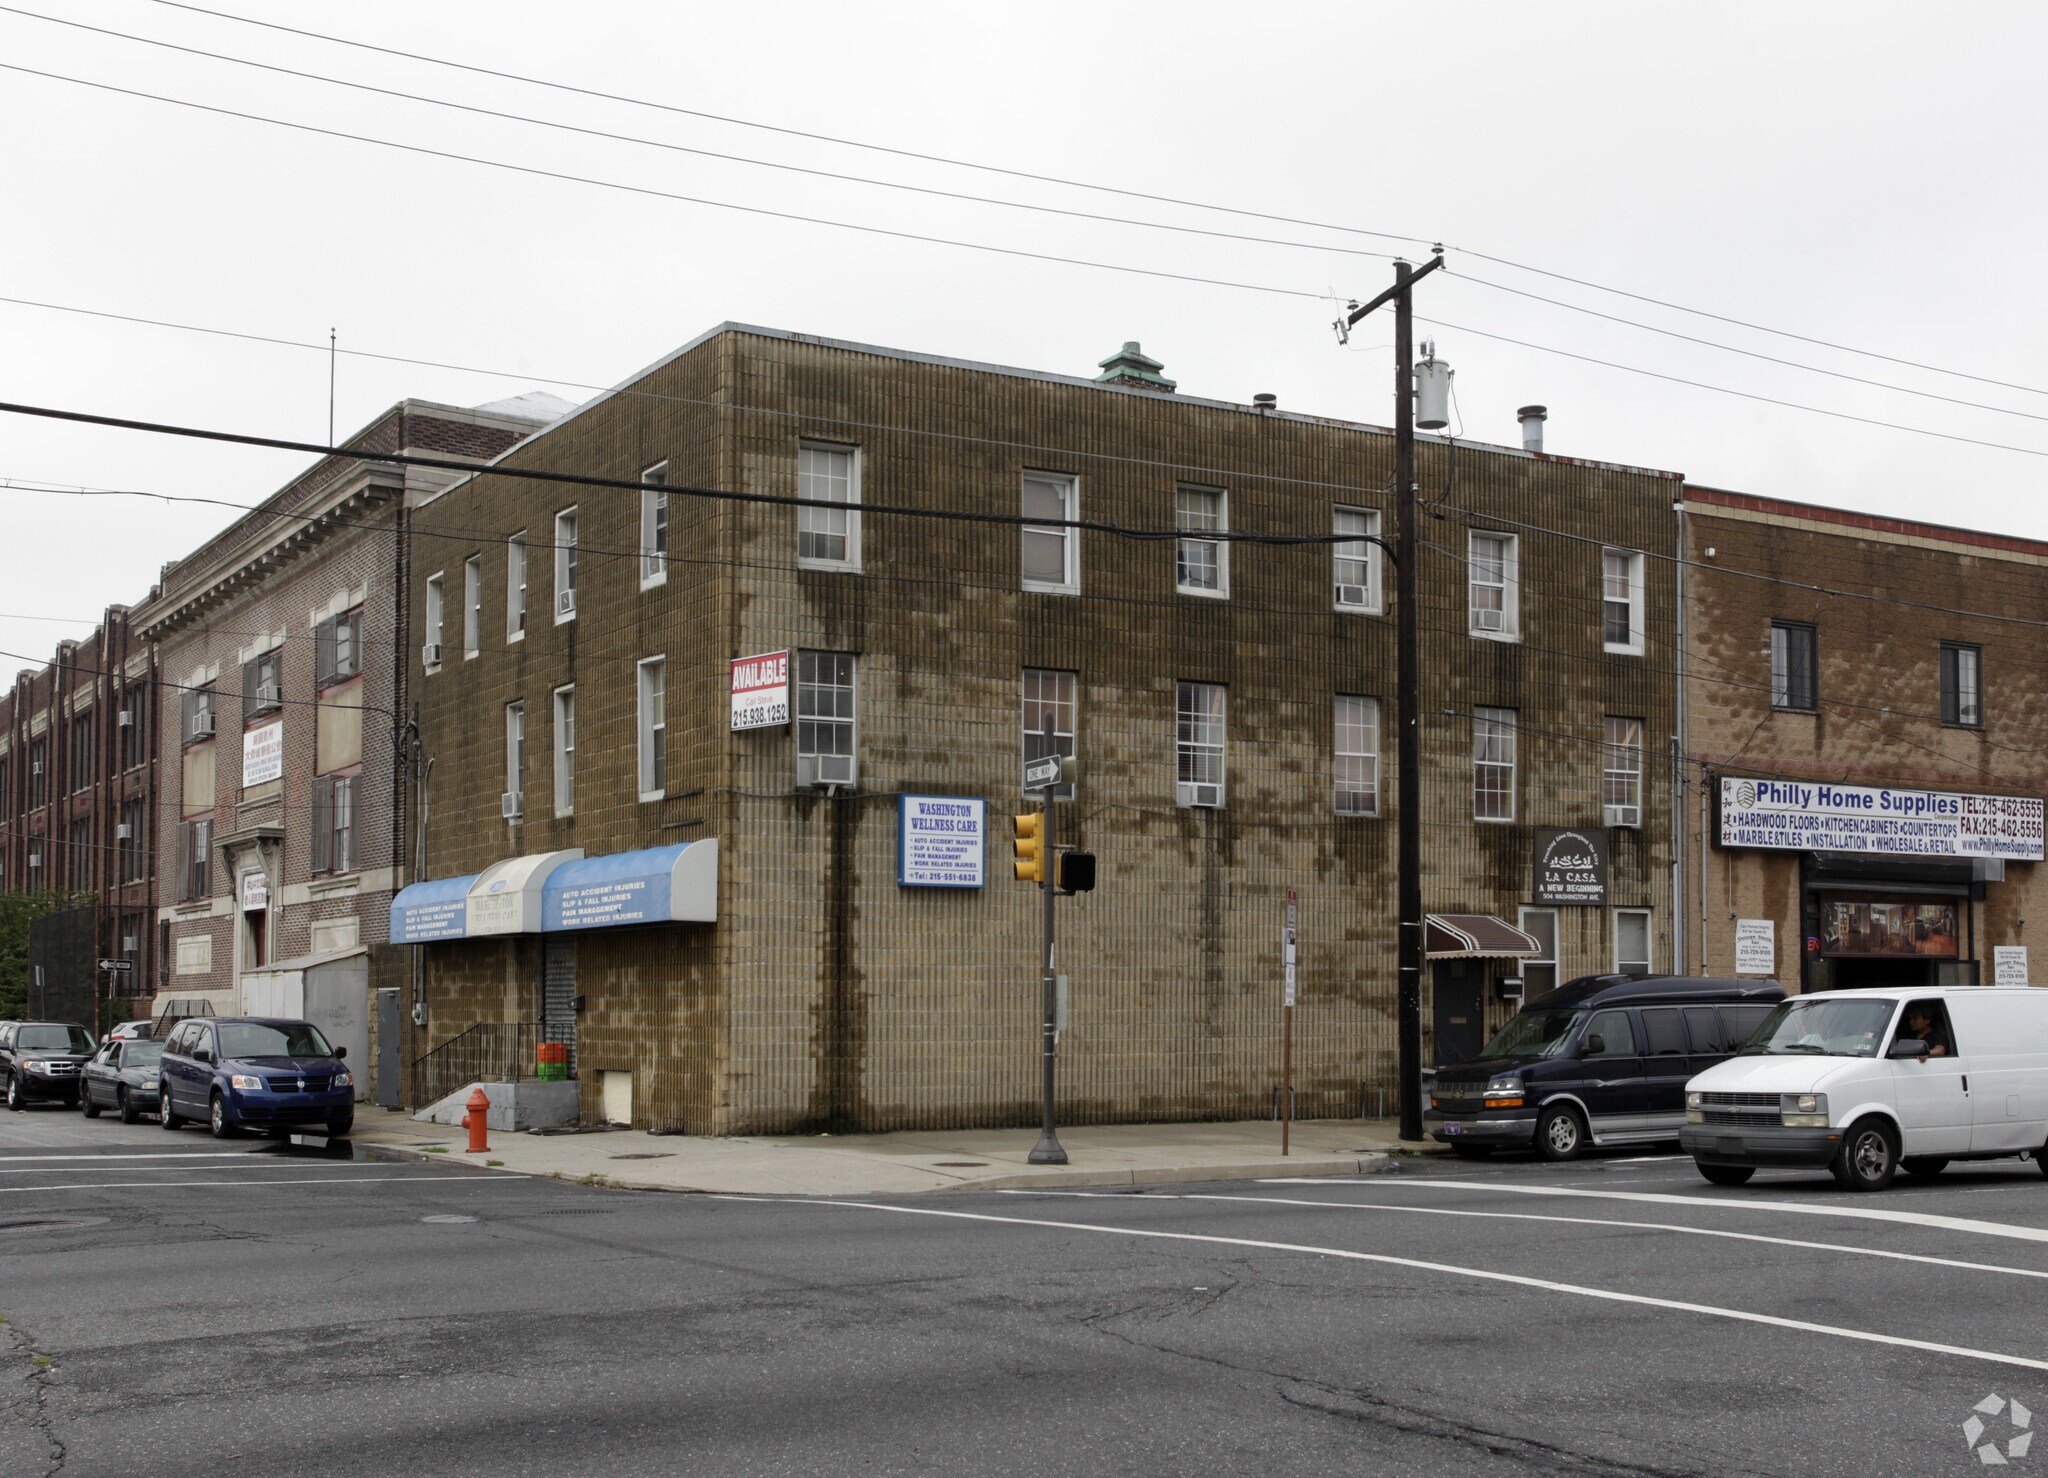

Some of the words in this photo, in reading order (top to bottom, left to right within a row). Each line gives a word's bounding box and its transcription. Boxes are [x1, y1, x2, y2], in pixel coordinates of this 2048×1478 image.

[732, 658, 786, 690] AVAILABLE
[746, 697, 756, 706] Call
[757, 696, 773, 705] Steve
[733, 704, 786, 726] 215.938.1252
[1029, 768, 1039, 780] ONE
[1041, 765, 1050, 776] WAY
[1757, 782, 1811, 809] Philly
[1818, 786, 1873, 809] Home
[1880, 790, 1958, 816] Supplies
[919, 802, 972, 817] WASHINGTON
[911, 817, 955, 832] WELLNESS
[956, 820, 977, 832] CARE
[1738, 812, 1786, 829] HARDWOOD
[1789, 815, 1819, 830] FLOORS
[1903, 821, 1957, 838] COUNTERTOPS
[1811, 833, 1867, 850] INSTALLATION
[915, 872, 928, 880] Tel:
[1545, 872, 1560, 882] LA
[1566, 872, 1597, 882] CASA
[562, 891, 579, 899] AUTO
[581, 886, 613, 896] ACCIDENT
[615, 881, 645, 892] INJURIES
[1539, 884, 1544, 892] A
[1547, 884, 1564, 892] NEW
[1566, 884, 1604, 893] BEGINNING
[562, 900, 576, 908] SLIP
[585, 897, 600, 905] FALL
[602, 893, 631, 903] INJURIES
[419, 906, 441, 914] ACCIDENT
[442, 902, 464, 911] INJURIES
[578, 904, 622, 914] MANAGEMENT
[434, 912, 455, 920] INJURIES
[562, 918, 580, 926] WORK
[583, 915, 610, 924] RELATED
[613, 912, 643, 920] INJURIES
[417, 921, 448, 930] MANAGEMENT
[420, 930, 440, 938] RELATED
[441, 928, 463, 936] INJURIES
[1808, 940, 1820, 951] EN
